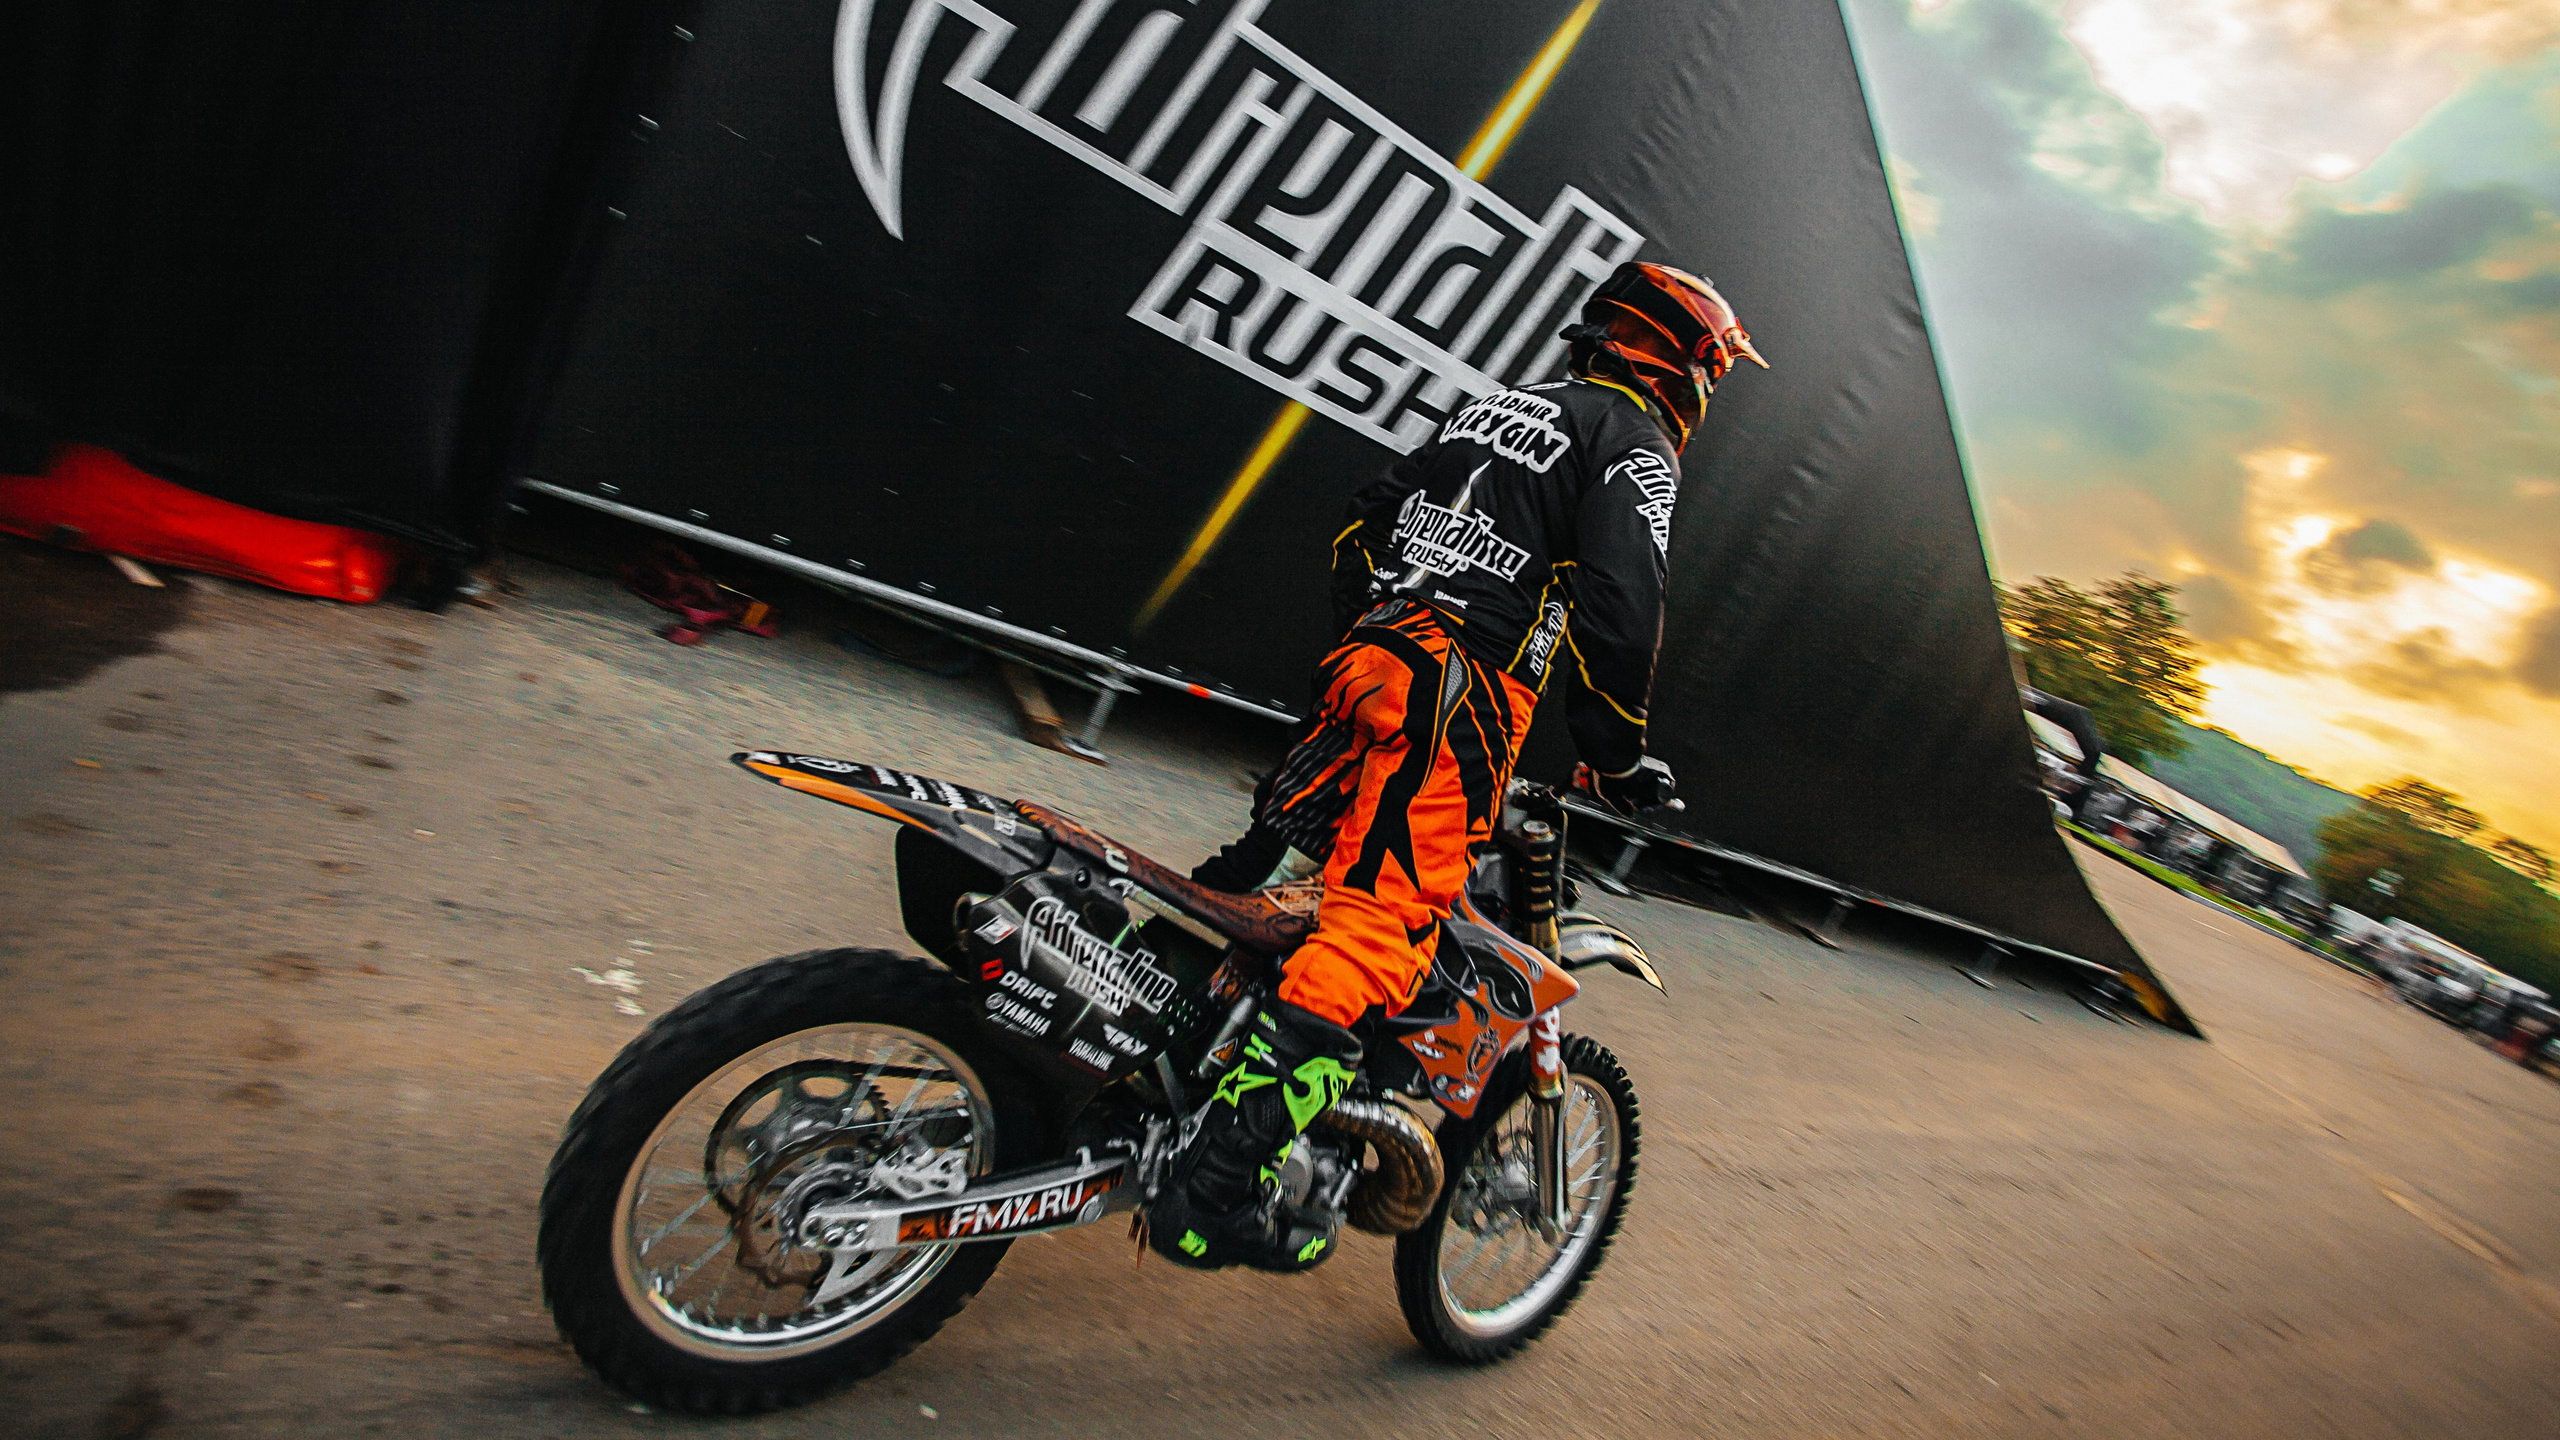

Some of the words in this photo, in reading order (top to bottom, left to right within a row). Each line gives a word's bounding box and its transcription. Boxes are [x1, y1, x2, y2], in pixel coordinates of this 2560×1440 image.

[1401, 541, 1461, 578] RUSH
[1020, 896, 1178, 1014] Adrenaline
[1000, 994, 1052, 1036] YAMAHA
[949, 1181, 1086, 1238] FMX.RU
